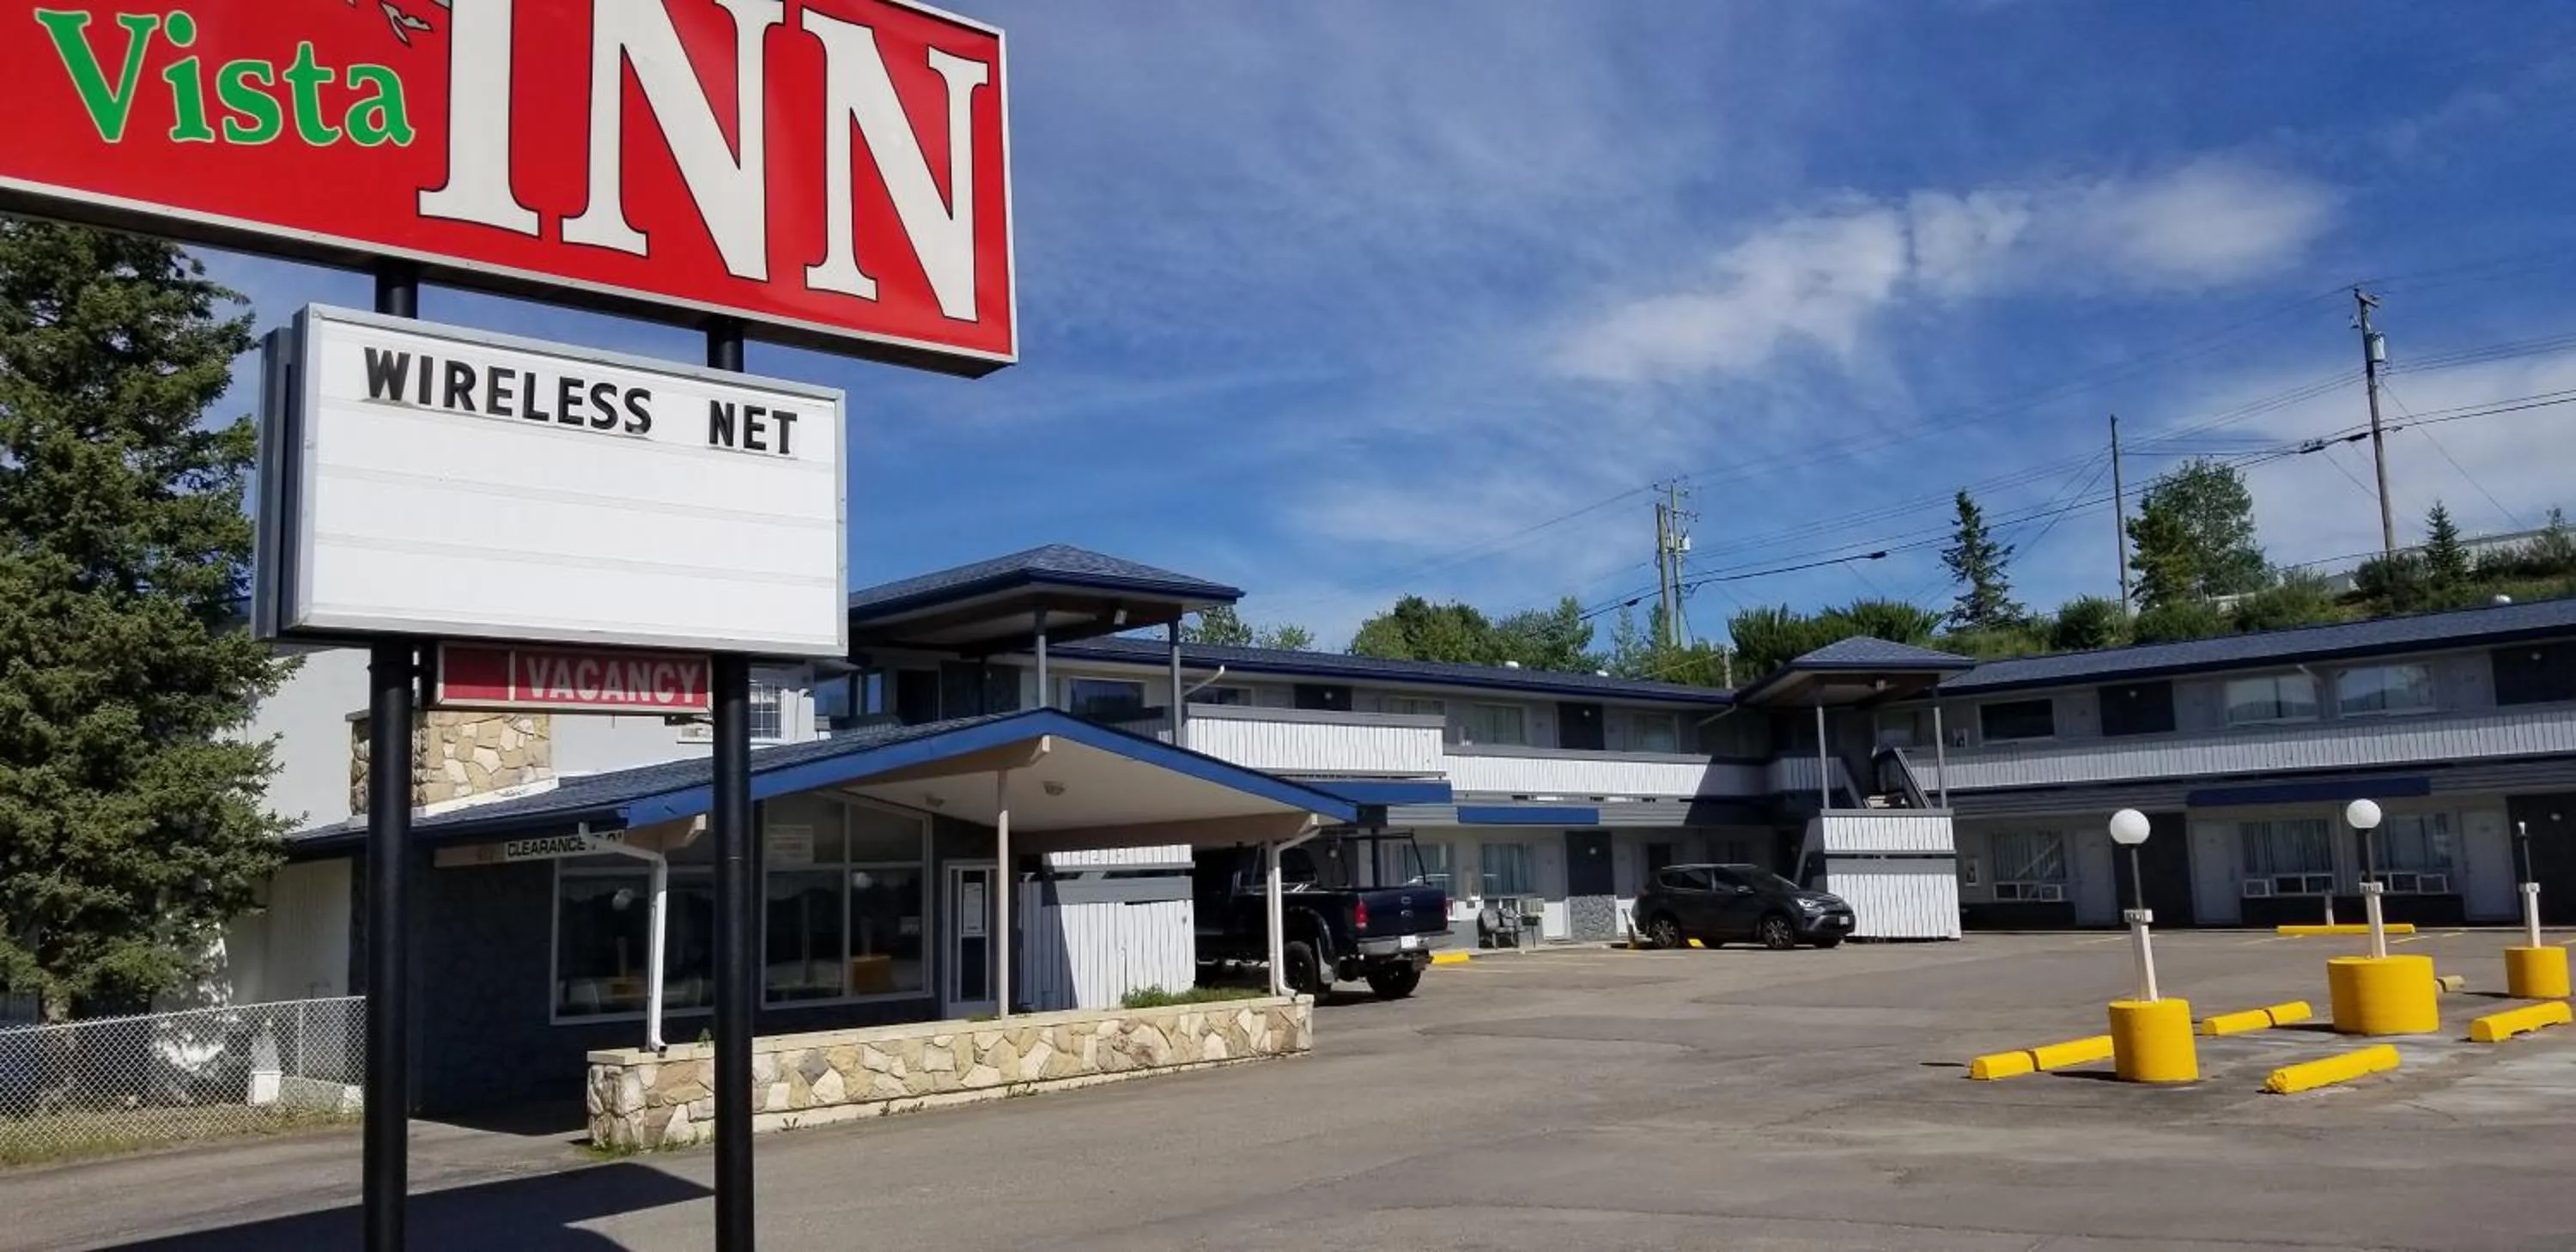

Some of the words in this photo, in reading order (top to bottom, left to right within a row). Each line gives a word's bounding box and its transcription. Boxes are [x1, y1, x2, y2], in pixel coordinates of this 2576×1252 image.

[35, 6, 416, 148] Vista
[416, 0, 989, 323] INN
[364, 346, 653, 435] WIRELESS
[708, 399, 798, 454] NET
[526, 657, 701, 703] VACANCY
[507, 835, 586, 857] CLEARANCE
